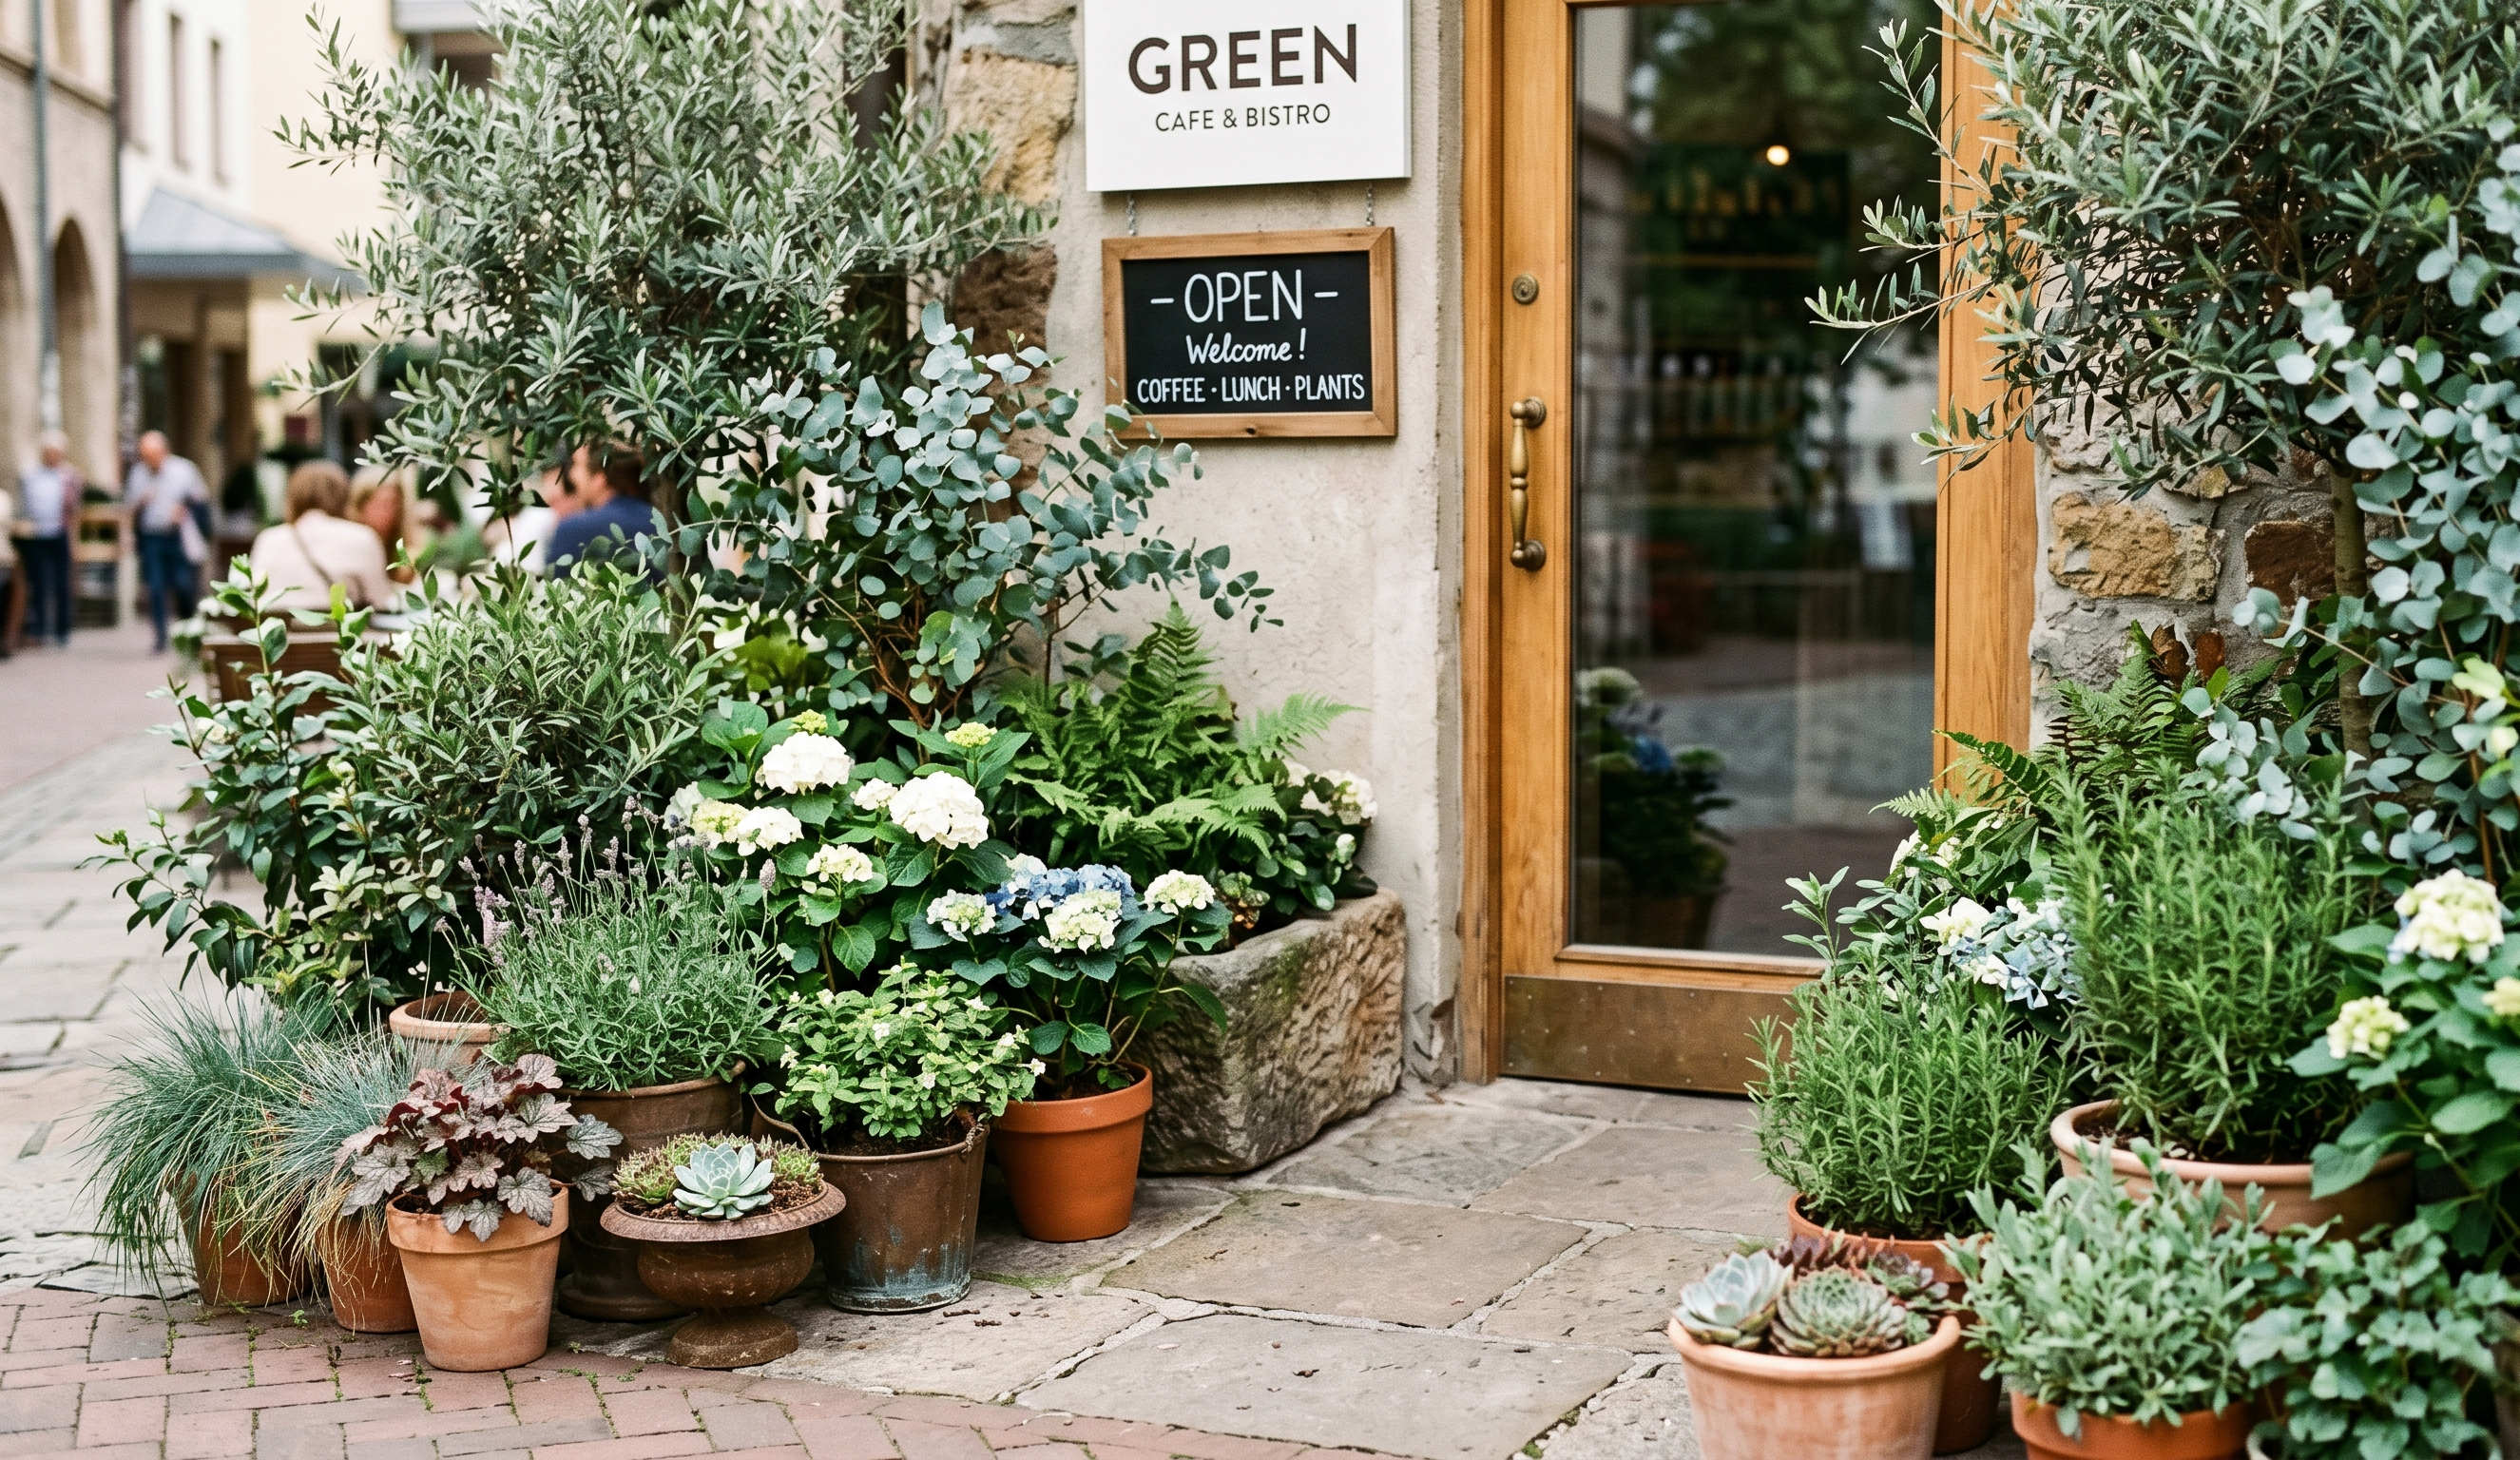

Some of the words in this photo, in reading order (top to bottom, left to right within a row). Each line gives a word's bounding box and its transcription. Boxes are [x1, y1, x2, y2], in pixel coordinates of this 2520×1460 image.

[1128, 24, 1356, 94] GREEN
[1155, 110, 1214, 132] CAFE
[1222, 108, 1238, 129] &
[1246, 104, 1331, 127] BISTRO
[1183, 269, 1303, 323] OPEN
[1185, 328, 1307, 364] Welcome!
[1137, 377, 1206, 404] COFFEE
[1222, 375, 1281, 402] LUNCH
[1295, 374, 1366, 401] PLANTS
